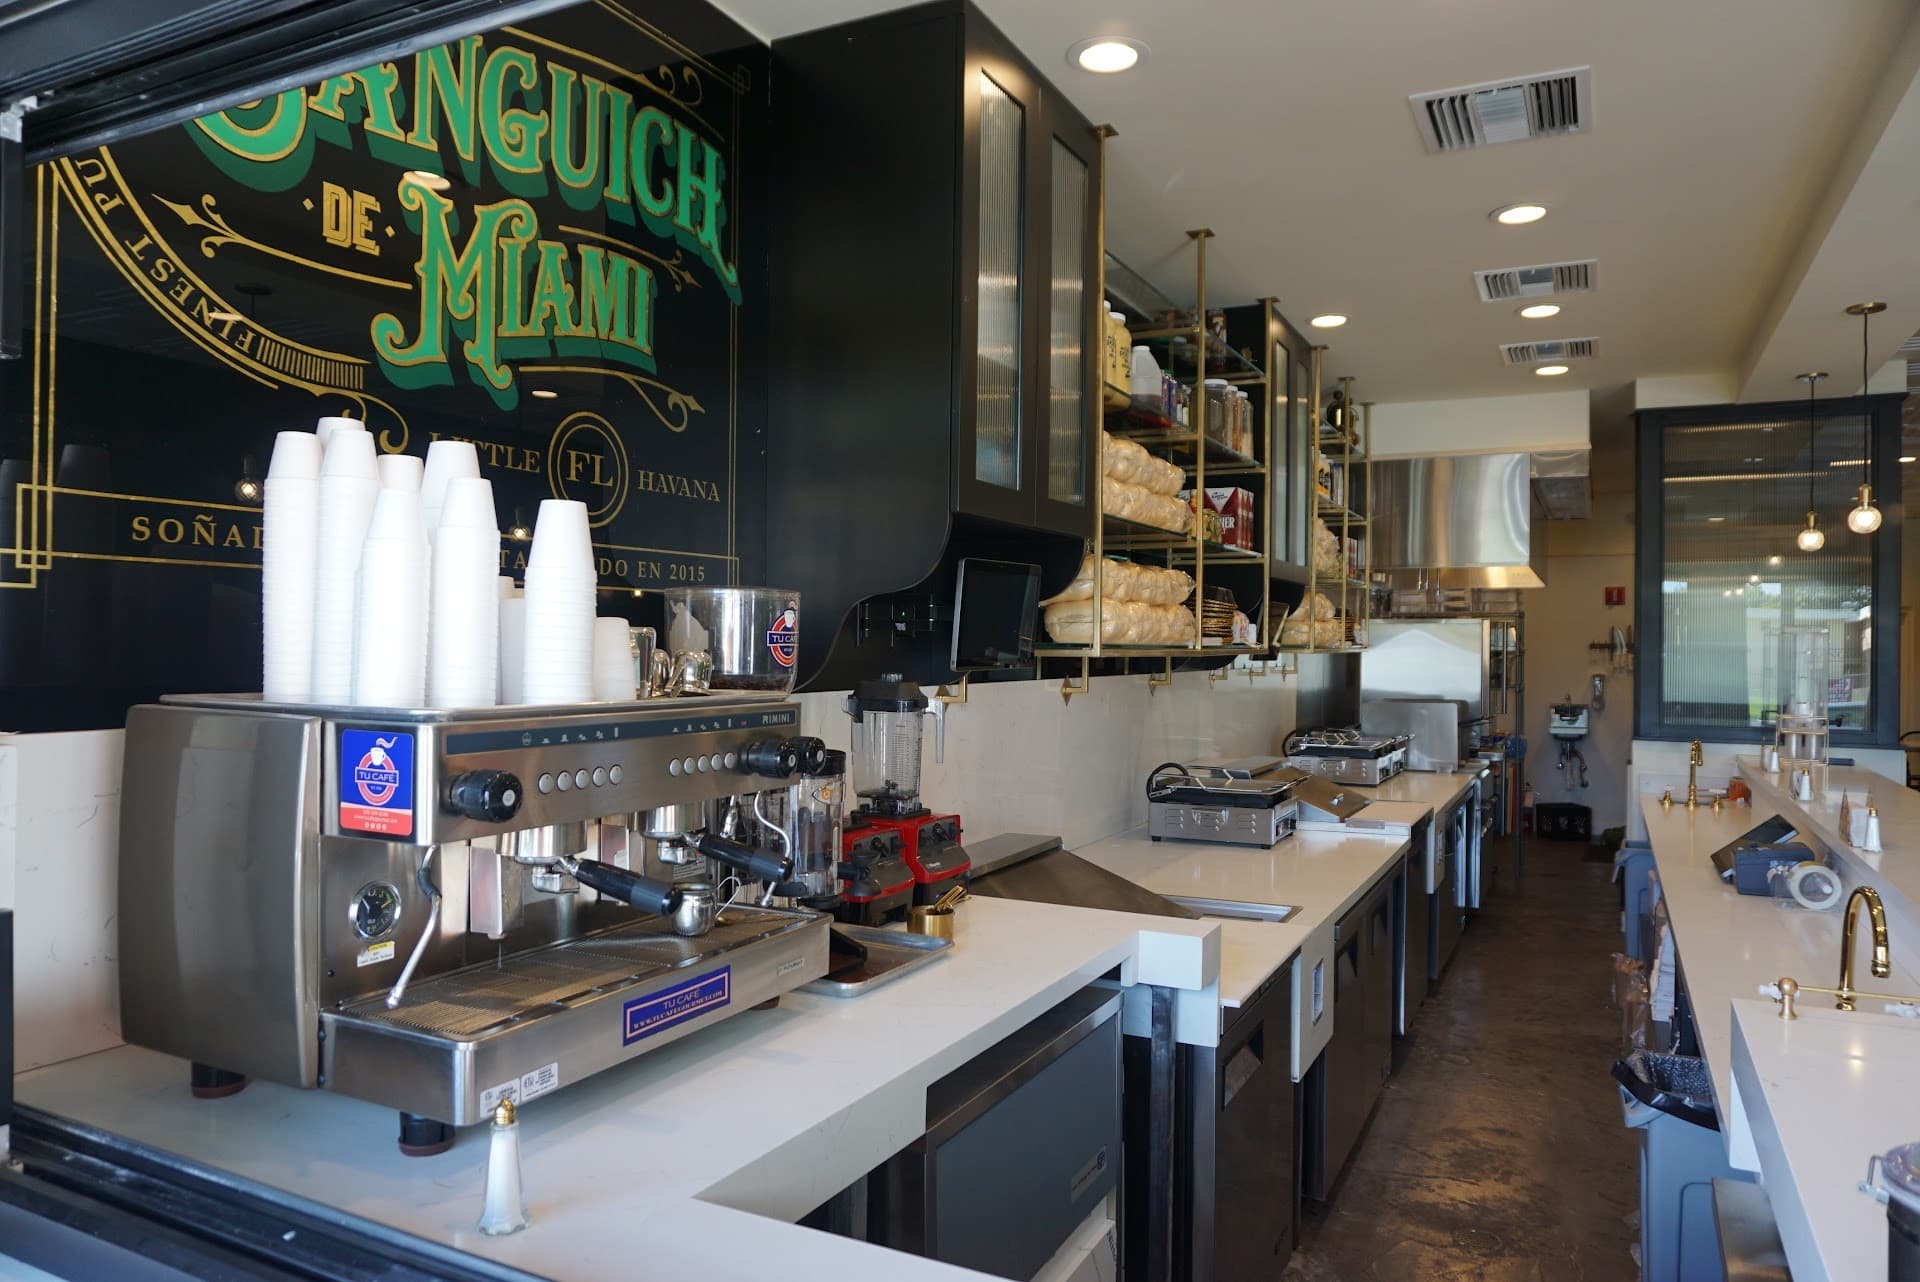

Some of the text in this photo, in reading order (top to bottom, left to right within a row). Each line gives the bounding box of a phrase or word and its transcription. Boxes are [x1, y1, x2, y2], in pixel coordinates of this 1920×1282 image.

[322, 181, 381, 256] DE
[124, 234, 257, 354] FINEST
[371, 183, 653, 389] MIAMI
[566, 449, 614, 487] FL
[636, 469, 721, 502] HAVANA
[637, 560, 661, 579] EN
[669, 563, 705, 582] 2015
[771, 634, 784, 643] TU
[762, 713, 790, 725] RIMINI
[359, 771, 371, 780] TU
[663, 1000, 676, 1010] TU
